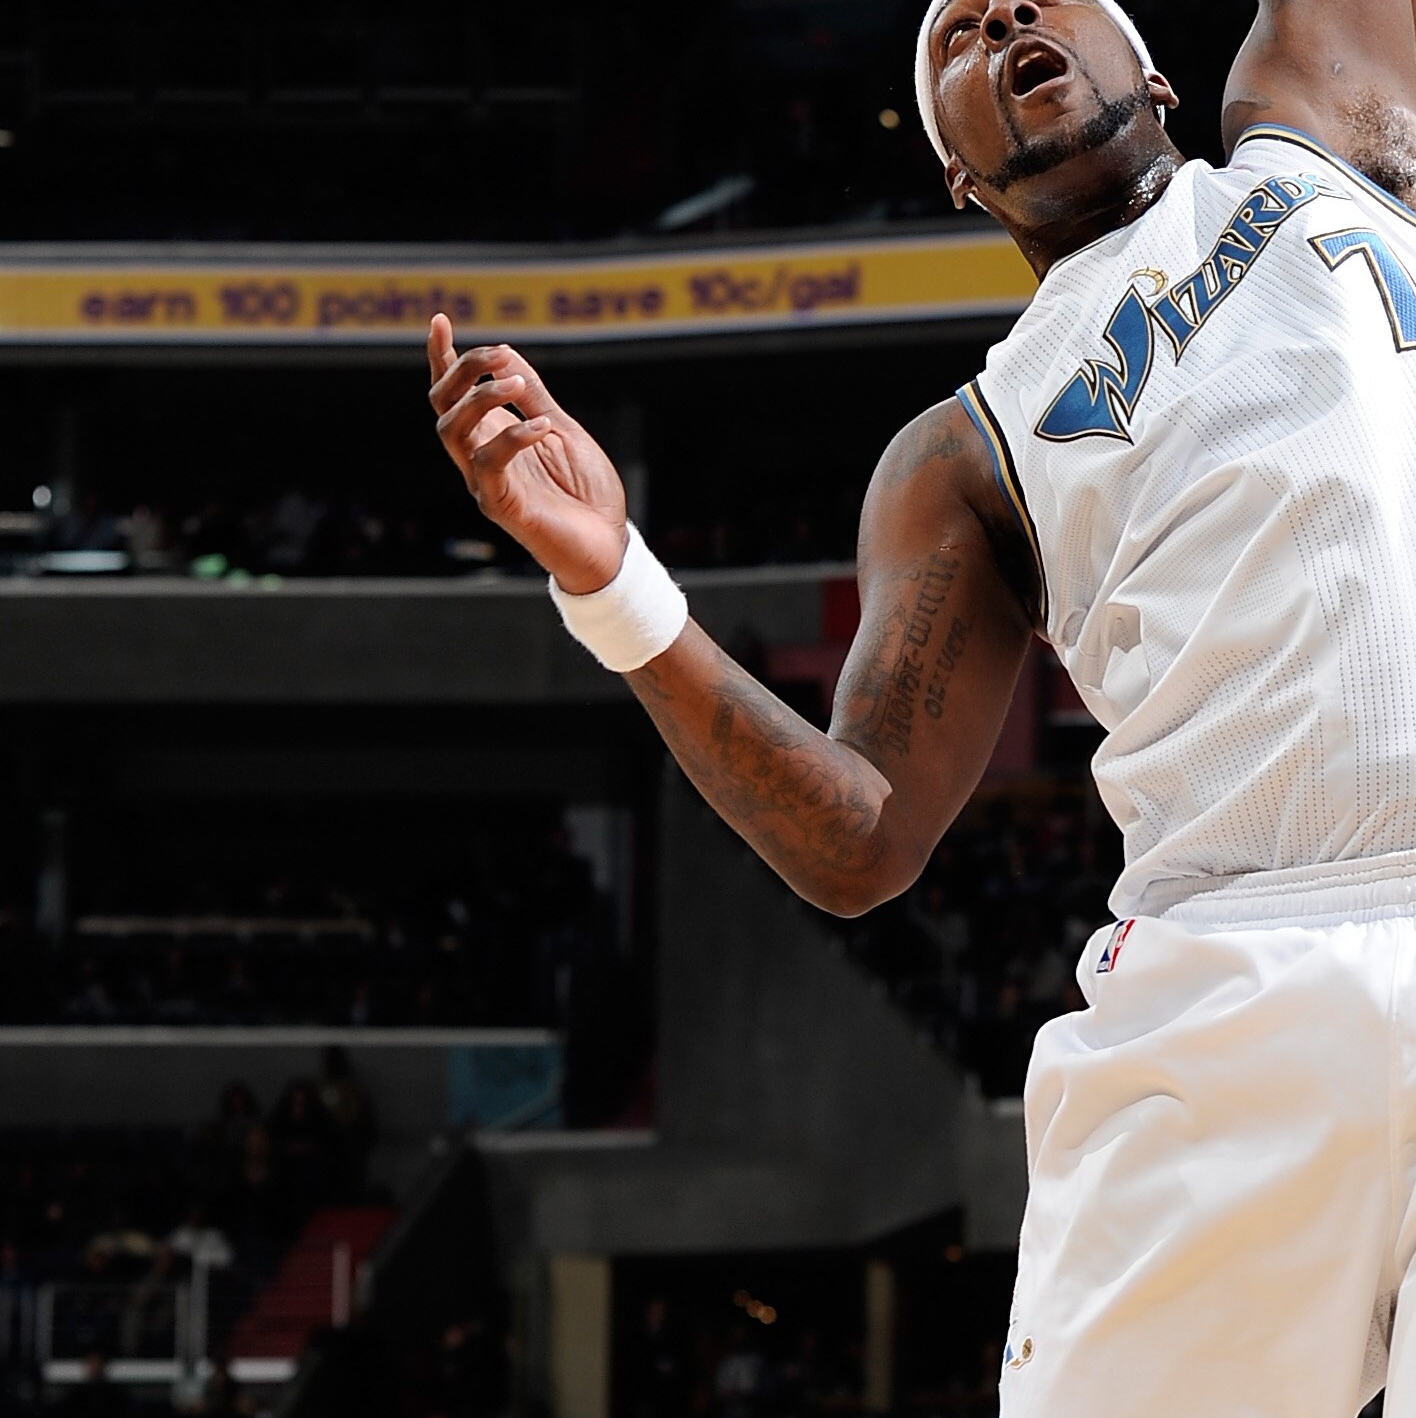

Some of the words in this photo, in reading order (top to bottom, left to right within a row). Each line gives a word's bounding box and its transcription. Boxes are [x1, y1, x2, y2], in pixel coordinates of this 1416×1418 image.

[81, 290, 196, 324] earn
[220, 282, 298, 322] 100
[318, 280, 476, 334] points
[549, 287, 664, 322] save
[688, 259, 862, 319] 10c/gal
